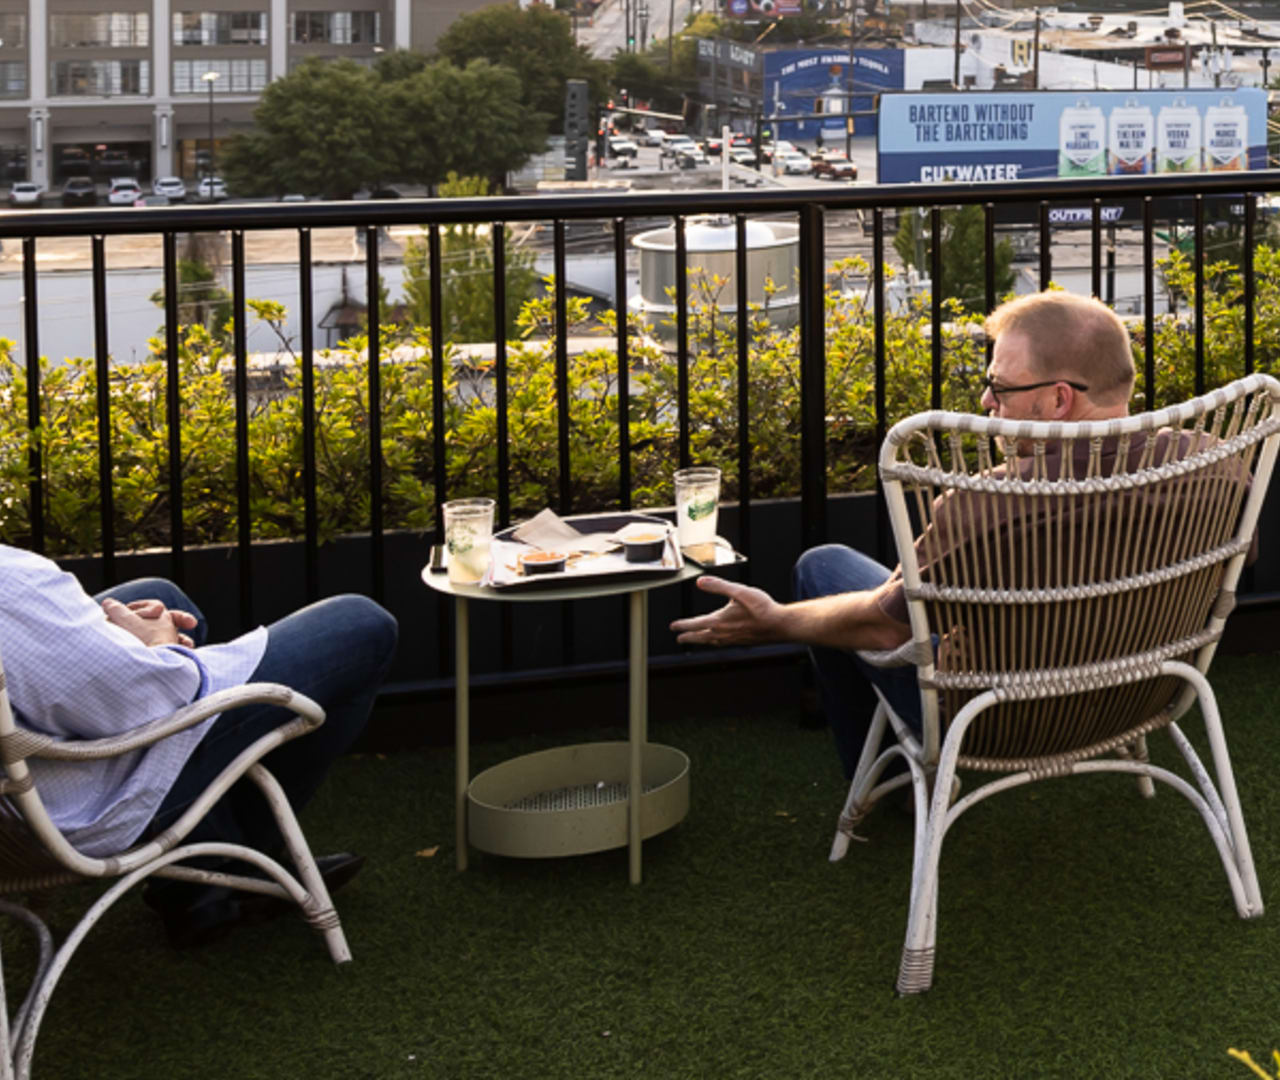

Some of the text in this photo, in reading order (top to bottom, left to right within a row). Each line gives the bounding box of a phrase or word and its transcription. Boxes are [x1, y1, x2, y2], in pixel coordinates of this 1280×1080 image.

[909, 103, 1035, 123] BARTEND WITHOUT
[915, 123, 1029, 142] THE BARTENDING
[920, 164, 1018, 182] CUTWATER
